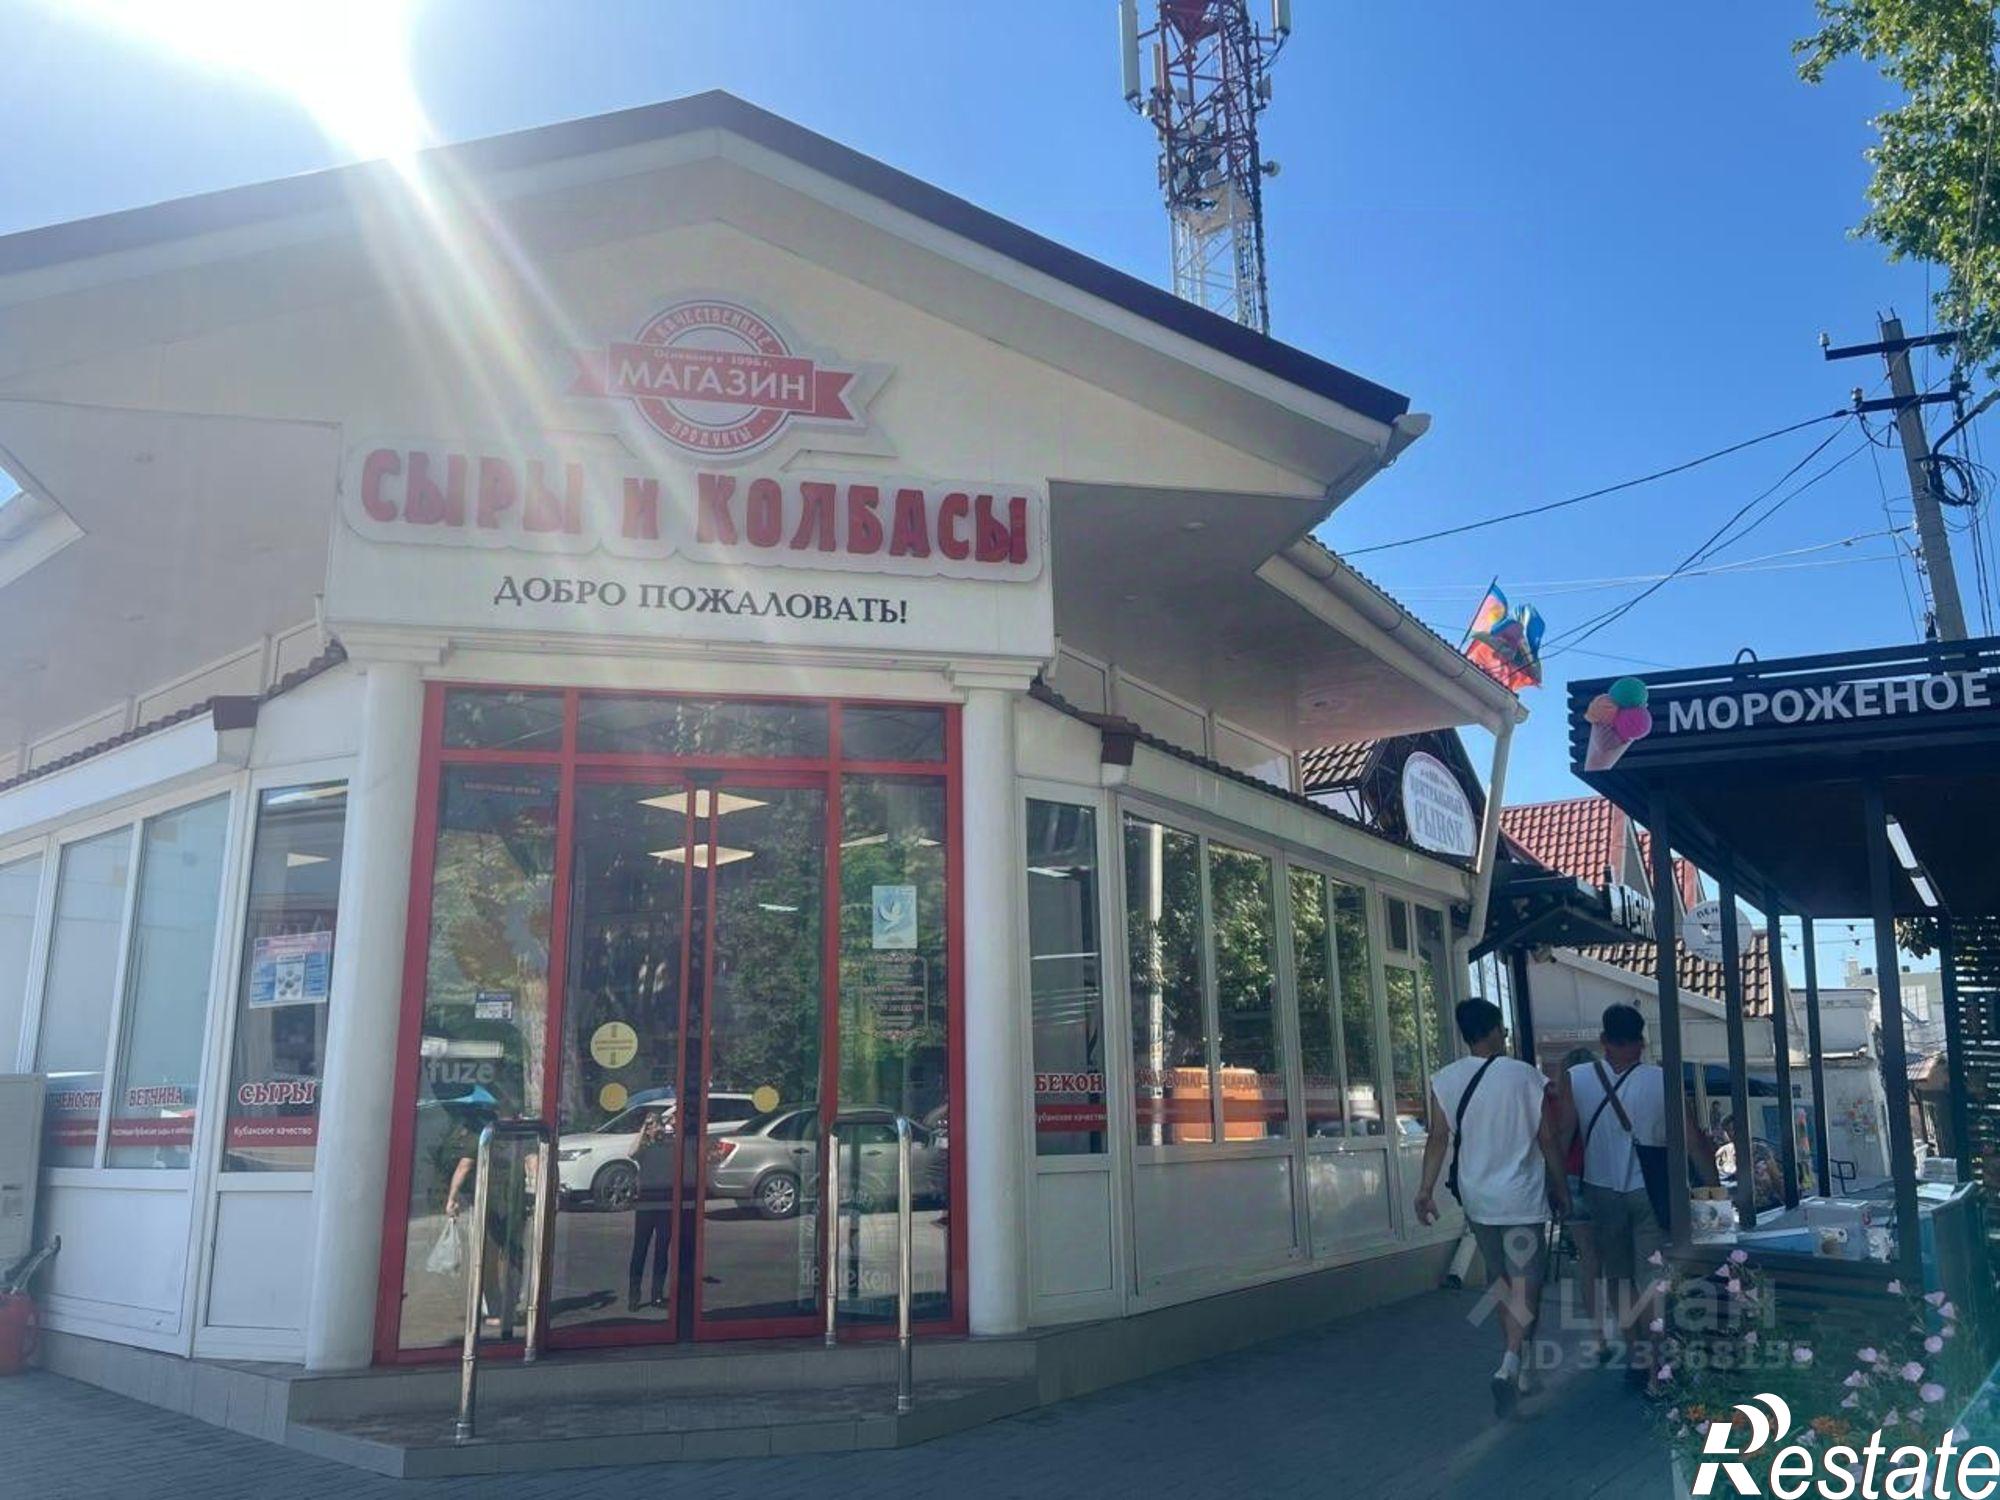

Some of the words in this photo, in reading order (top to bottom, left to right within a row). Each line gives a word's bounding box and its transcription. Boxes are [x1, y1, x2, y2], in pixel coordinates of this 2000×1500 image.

[616, 359, 806, 401] МАГАЗИН
[670, 422, 753, 447] ПРОДУКТЫ
[360, 448, 584, 535] СЫРЫ
[695, 472, 1029, 565] КОЛБАСЫ
[495, 576, 627, 607] ДОБРО
[639, 584, 908, 624] ПОЖАЛОВАТЬ!
[1669, 671, 1991, 733] МОРОЖЕНОЕ
[428, 1059, 495, 1083] fuze
[1034, 1073, 1105, 1093] БЕКОН
[129, 1086, 183, 1107] ВЕТЧИНА
[239, 1081, 316, 1105] СЫРЫ
